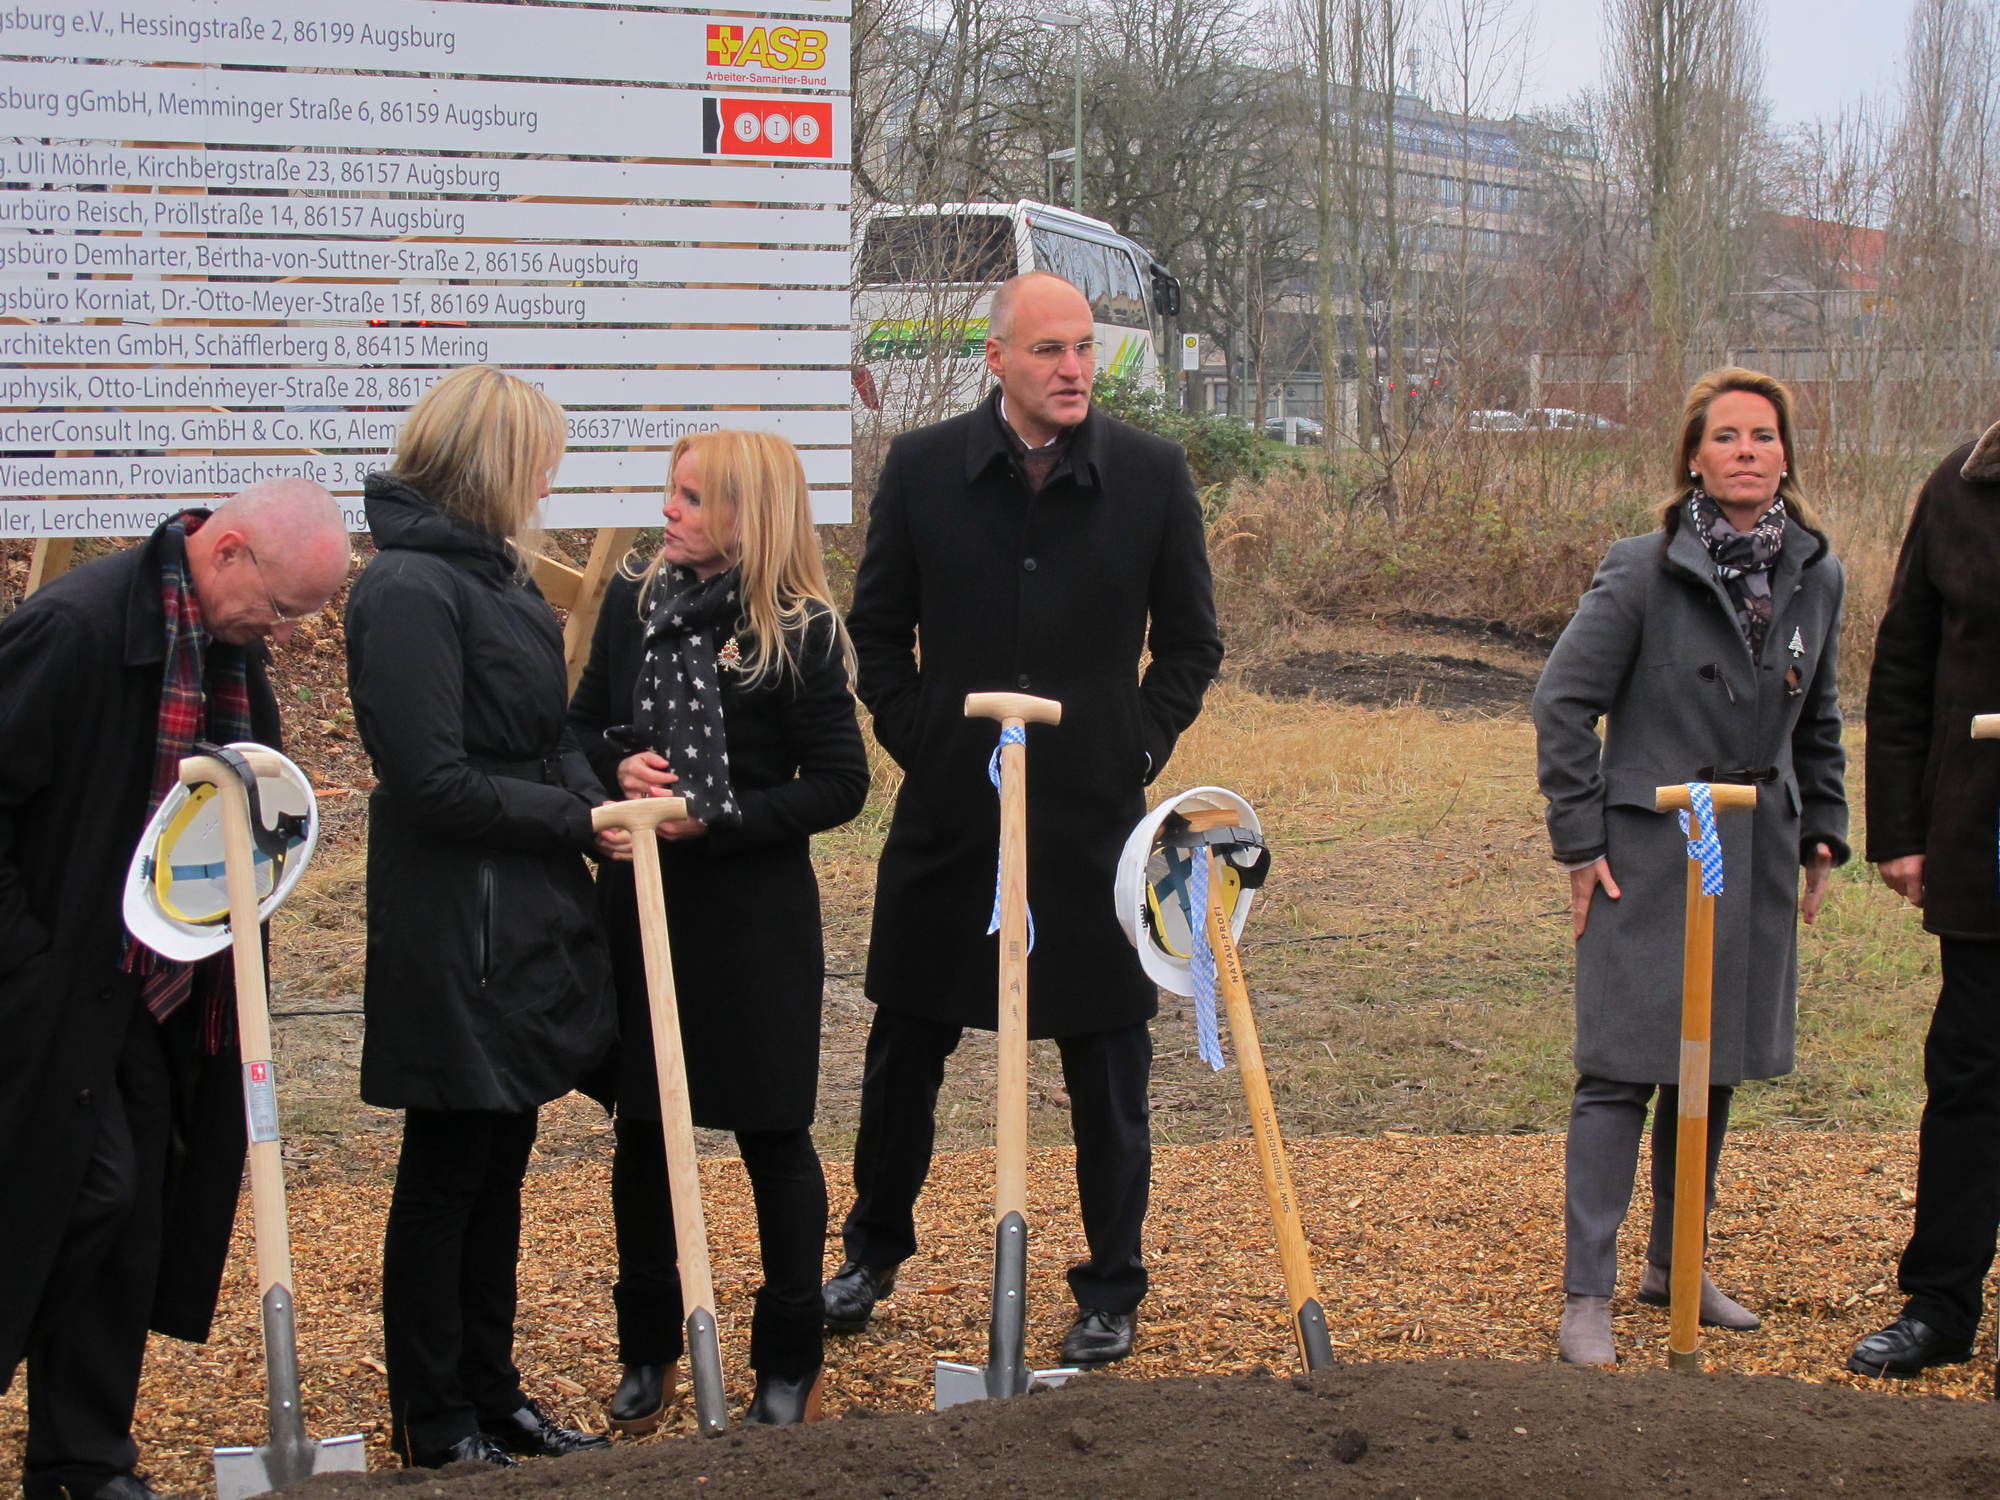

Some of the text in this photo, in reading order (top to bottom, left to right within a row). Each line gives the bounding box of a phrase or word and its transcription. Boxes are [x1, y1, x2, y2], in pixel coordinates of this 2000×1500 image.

[0, 6, 454, 54] sburg e.V., Hessingstraße 2, 86199 Augsburg
[733, 26, 829, 71] ASB
[706, 71, 827, 86] Arbeiter-Samariter-Bund
[66, 89, 151, 117] gGmbH,
[159, 93, 283, 123] Memminger
[290, 97, 352, 120] Straße
[359, 101, 374, 125] 6,
[381, 101, 439, 123] 86159
[445, 104, 537, 133] Augsburg
[18, 152, 44, 174] Uli
[53, 153, 131, 179] Möhrle,
[138, 154, 300, 184] Kirchbergstraße
[307, 161, 334, 185] 23,
[341, 162, 400, 183] 86157
[407, 163, 499, 191] Augsburg
[78, 200, 148, 227] Reisch,
[155, 203, 263, 225] Pröllstraße
[272, 205, 298, 229] 14,
[304, 206, 363, 227] 86157
[370, 207, 464, 235] Augsburg
[75, 243, 191, 270] Demharter,
[198, 246, 458, 273] Bertha-von-Suttner-Straße
[465, 251, 480, 275] 2,
[486, 252, 542, 272] 86156
[549, 252, 637, 280] Augsburg
[76, 288, 155, 313] Korniat,
[162, 290, 384, 316] Dr.-Otto-Meyer-Straße
[392, 291, 424, 316] 15f,
[431, 294, 488, 314] 86169
[495, 294, 585, 320] Augsburg
[0, 332, 487, 362] rchitekten GmbH, Schäfflerberg 8, 86415 Mering
[88, 376, 348, 403] Otto-Lindenmeyer-Straße
[355, 377, 382, 400] 28,
[0, 419, 131, 442] cherConsult
[139, 420, 175, 447] Ing.
[182, 419, 245, 441] GmbH
[253, 419, 268, 440] &
[273, 419, 303, 440] Co.
[310, 419, 341, 443] KG,
[333, 462, 348, 485] 3,
[0, 508, 35, 533] ler,
